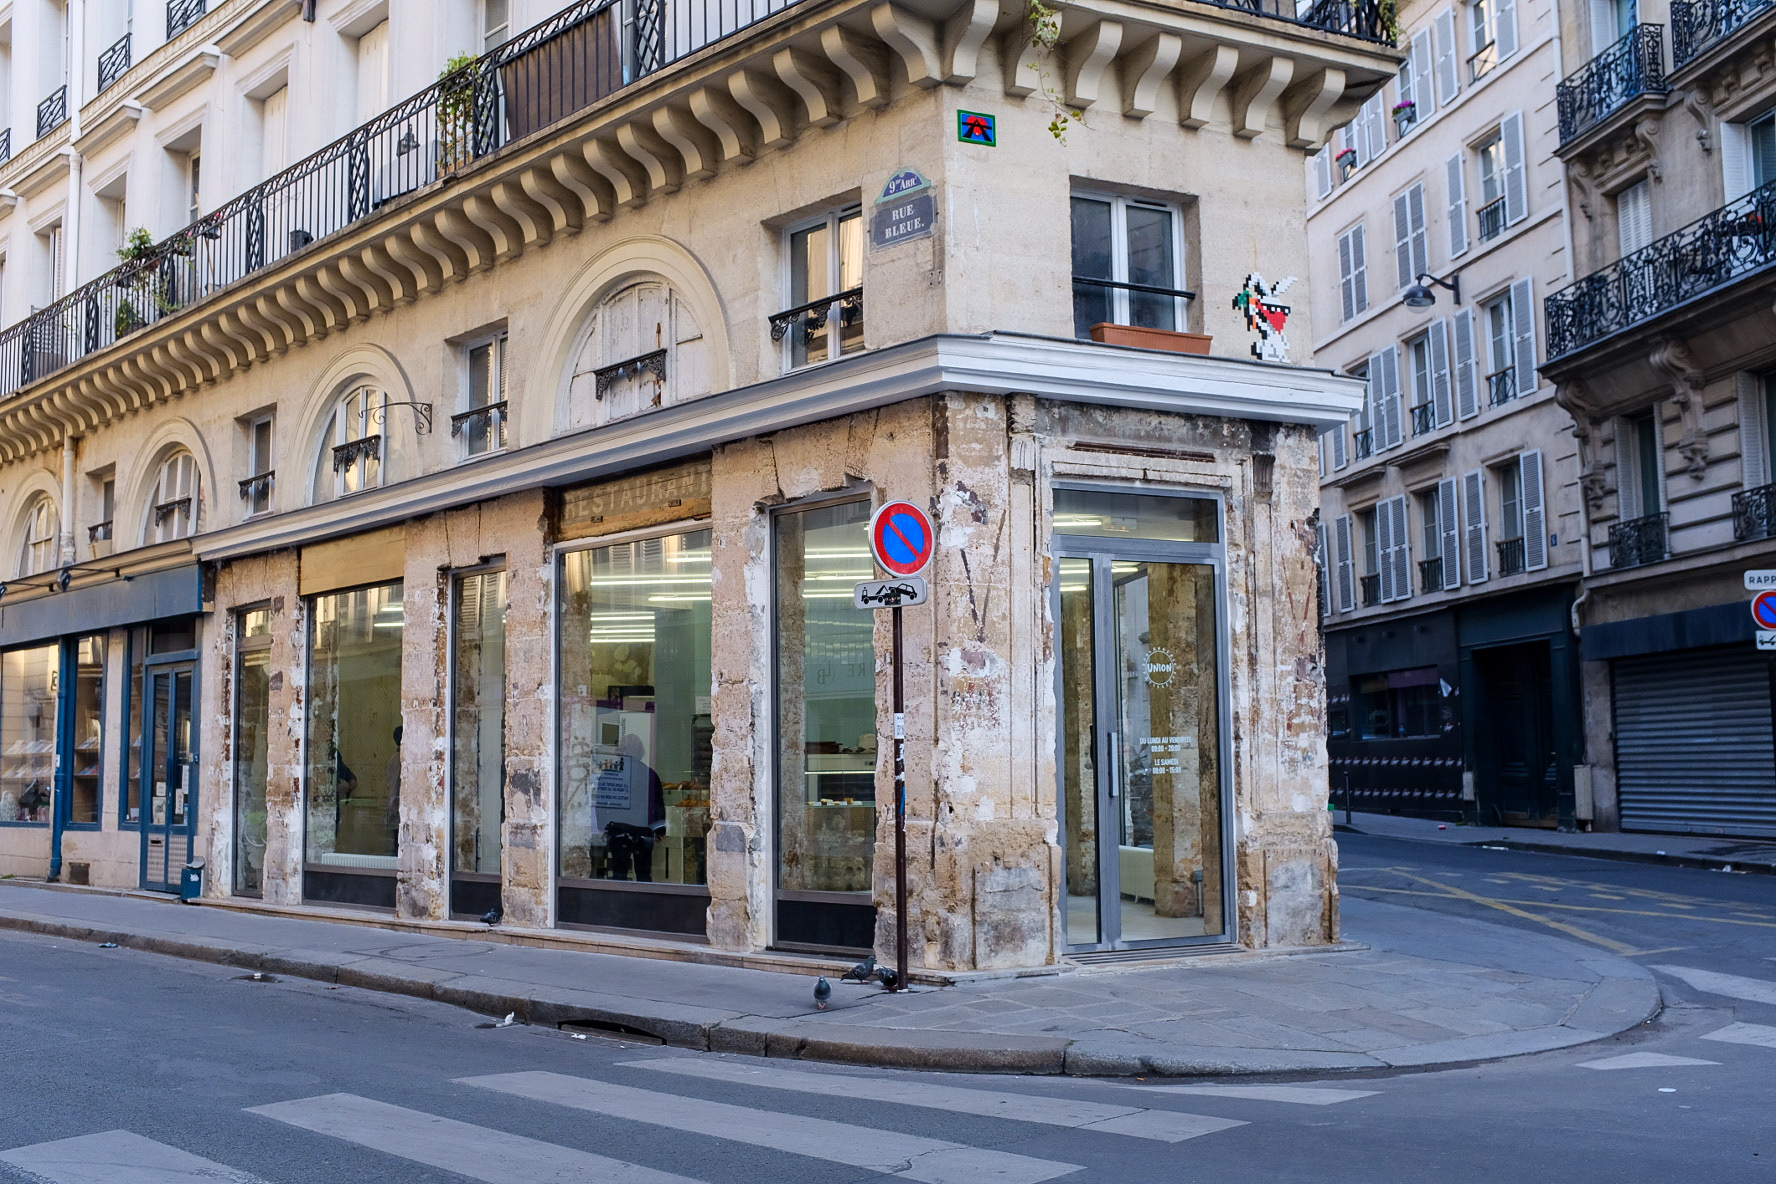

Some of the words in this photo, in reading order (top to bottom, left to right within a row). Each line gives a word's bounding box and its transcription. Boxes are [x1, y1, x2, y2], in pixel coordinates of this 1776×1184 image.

[892, 205, 914, 221] RUE
[885, 217, 924, 238] BLEUE.
[565, 465, 711, 520] RESTAURANT
[1147, 663, 1172, 672] UNION
